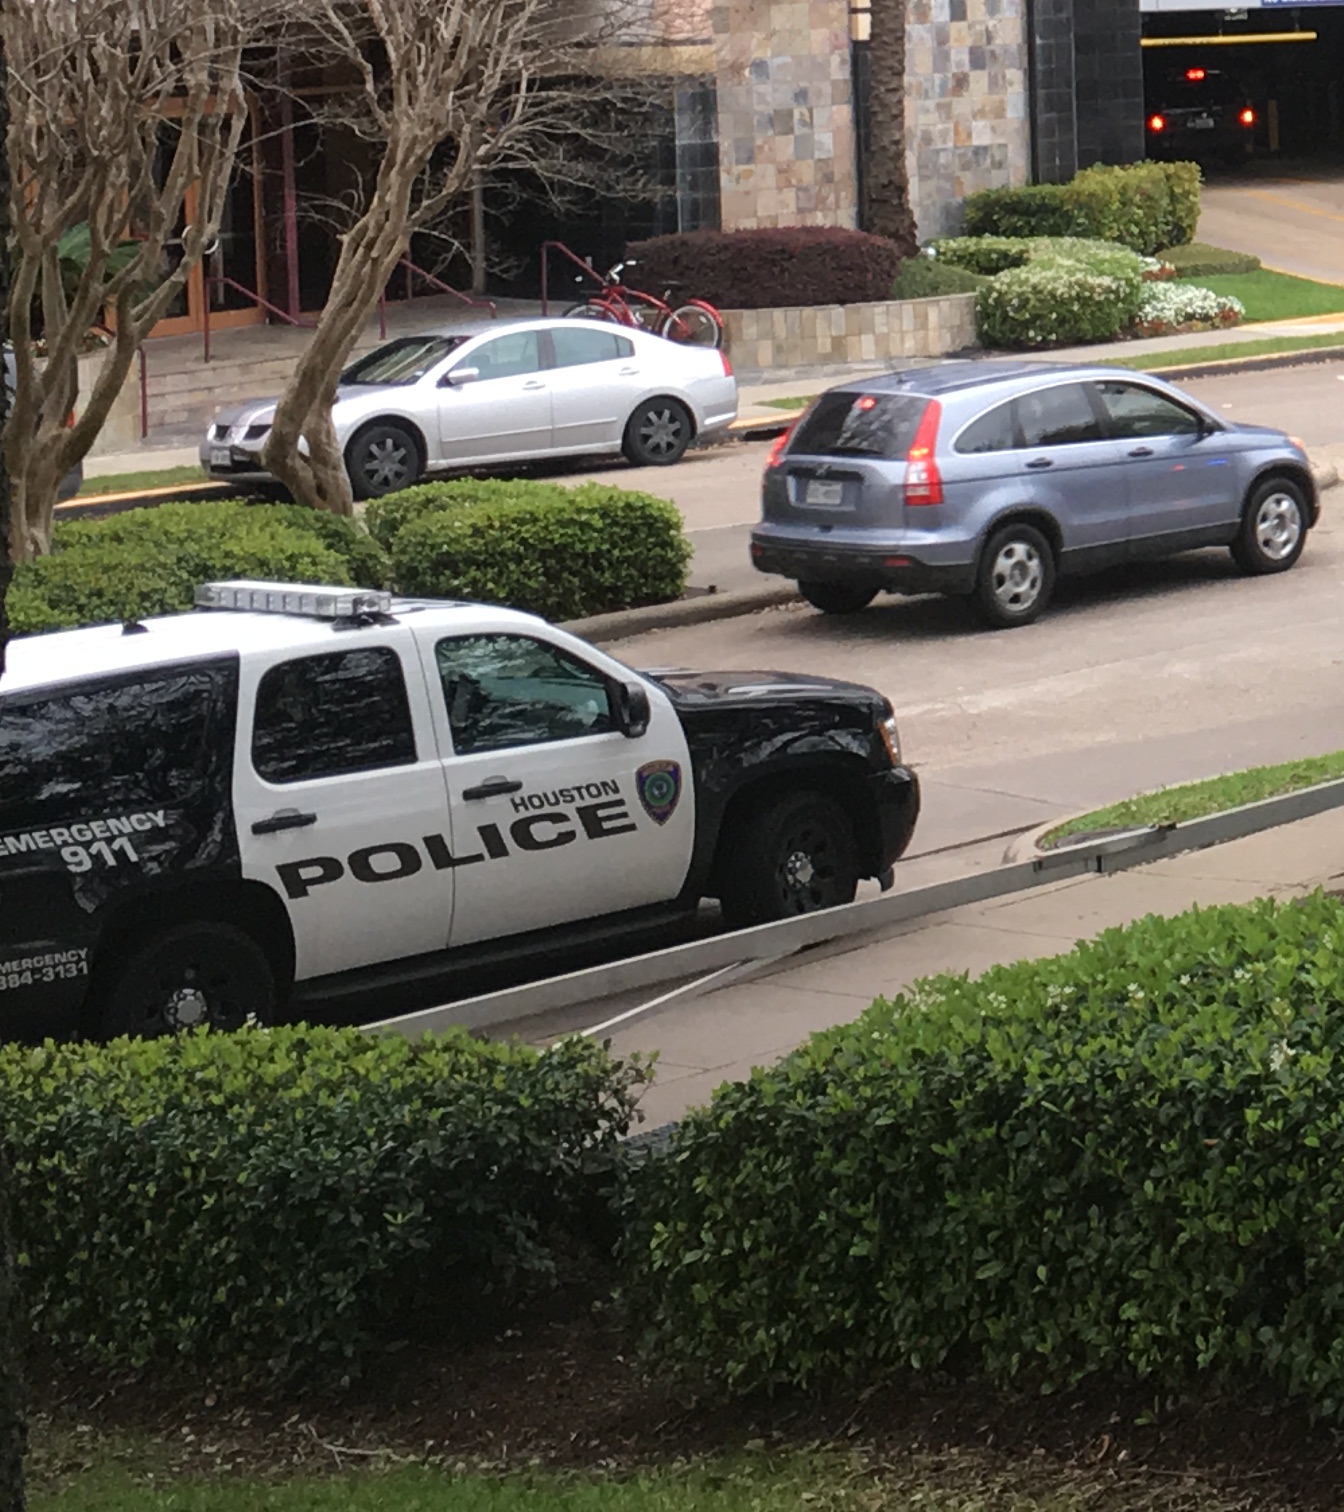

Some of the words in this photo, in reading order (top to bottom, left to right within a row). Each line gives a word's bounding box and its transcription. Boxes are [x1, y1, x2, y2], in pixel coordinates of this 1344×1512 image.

[510, 779, 620, 814] HOUSTON
[60, 837, 139, 873] 911
[274, 799, 638, 900] POLICE
